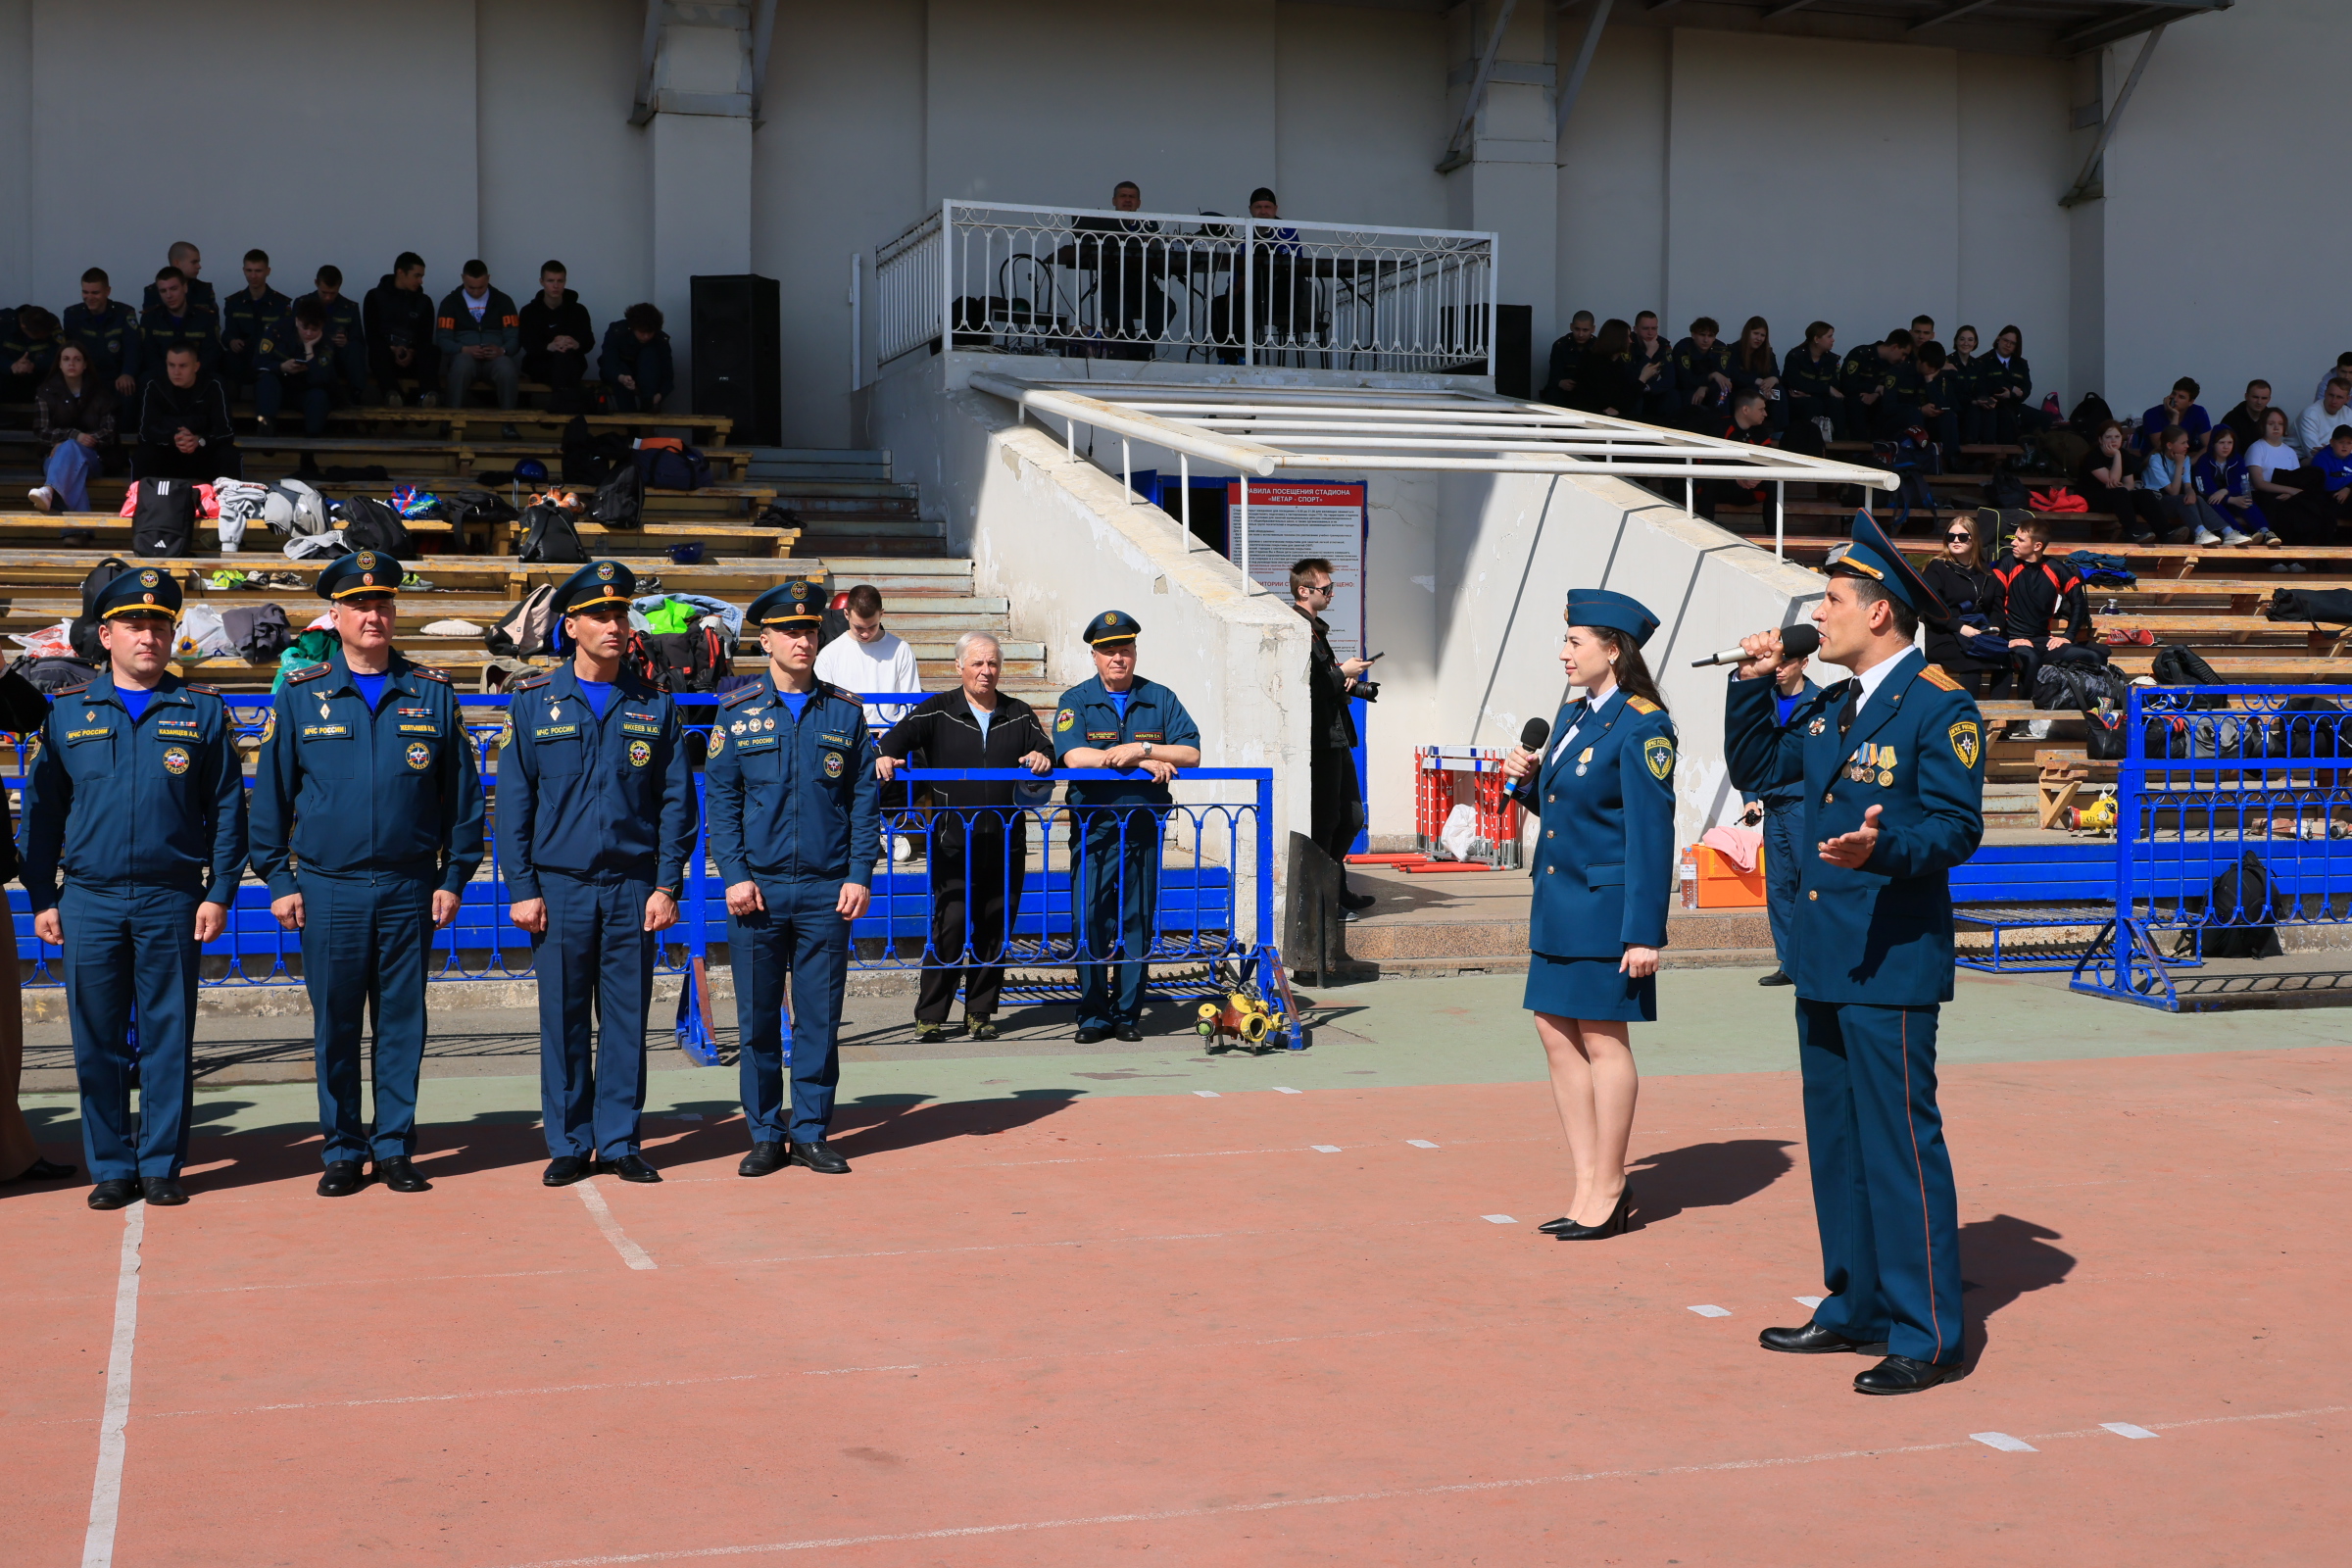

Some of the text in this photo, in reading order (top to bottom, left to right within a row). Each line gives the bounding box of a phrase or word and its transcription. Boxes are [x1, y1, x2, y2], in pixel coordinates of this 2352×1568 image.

[551, 725, 574, 734] РОССИИ
[623, 723, 646, 732] МИХЕЕВ
[68, 730, 81, 739] МЧС
[159, 728, 188, 737] КАЗАНЦЕВ
[752, 737, 773, 746] РОССИИ
